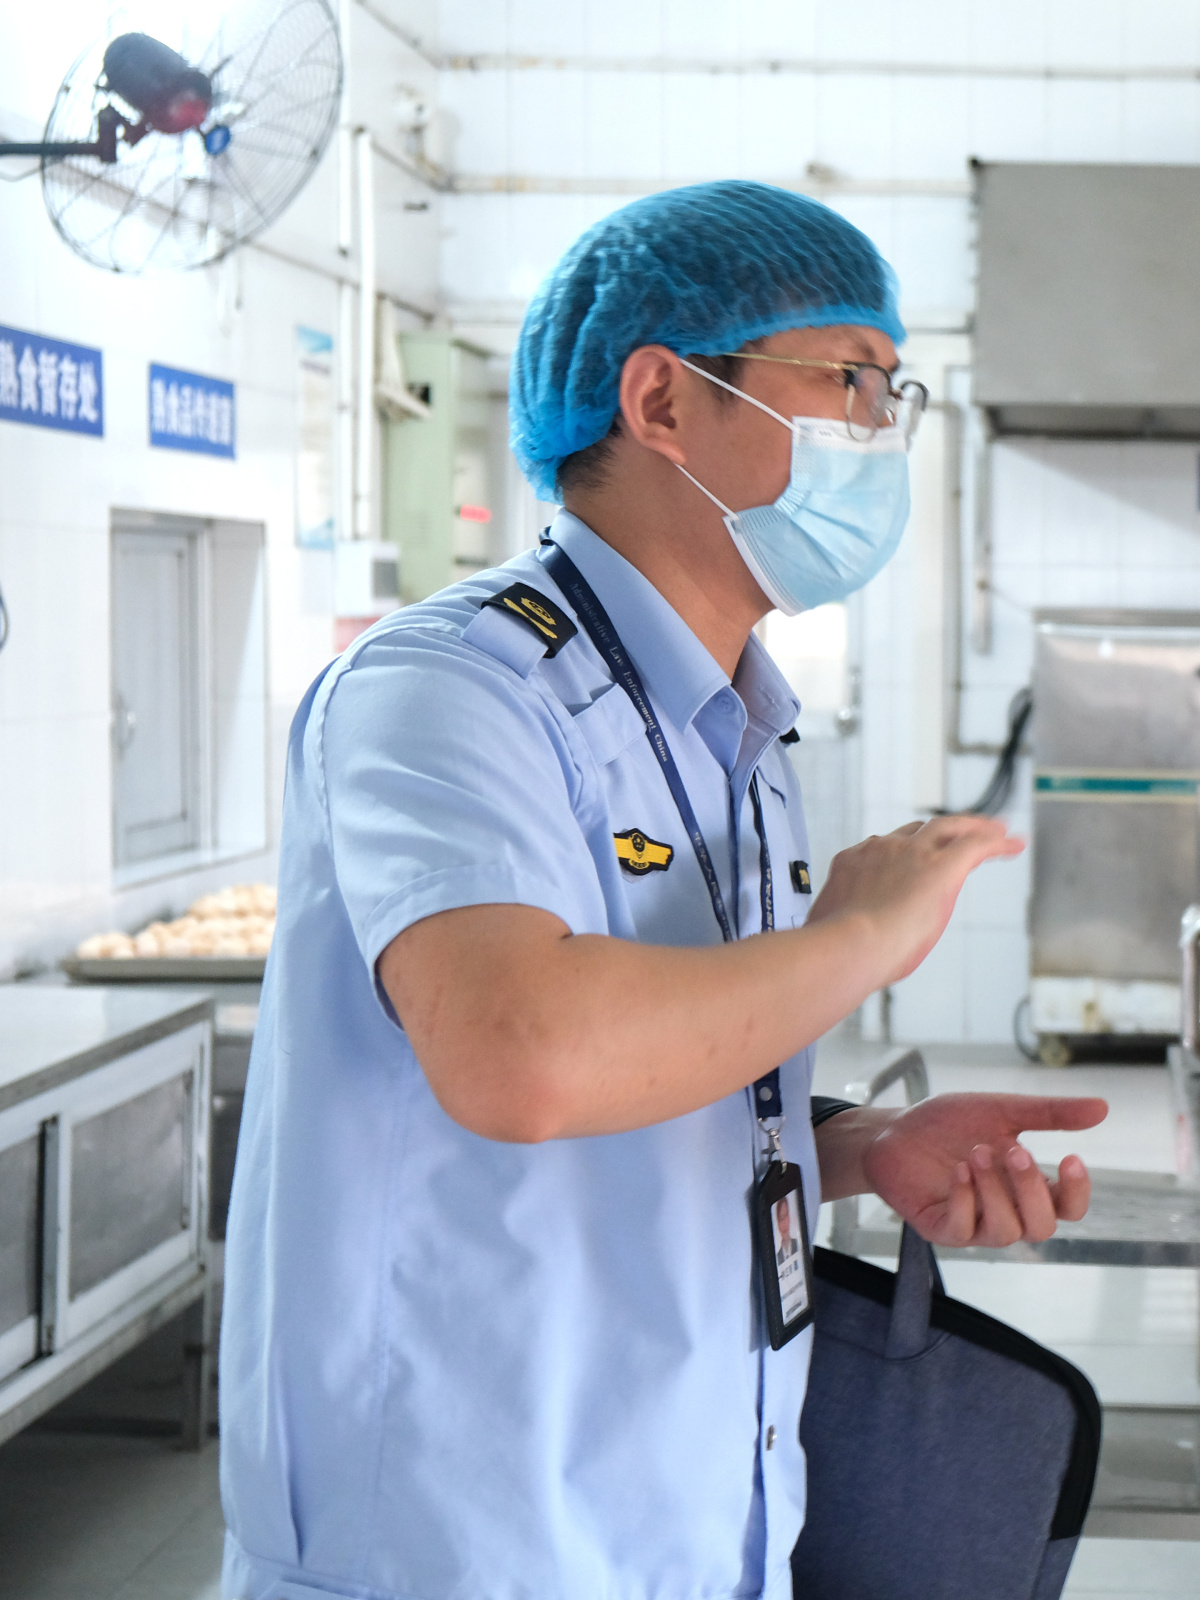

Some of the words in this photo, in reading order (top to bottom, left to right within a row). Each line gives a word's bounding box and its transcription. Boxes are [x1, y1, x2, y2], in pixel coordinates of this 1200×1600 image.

[609, 646, 625, 666] Law
[623, 671, 657, 730] Enforcement
[654, 733, 668, 762] China
